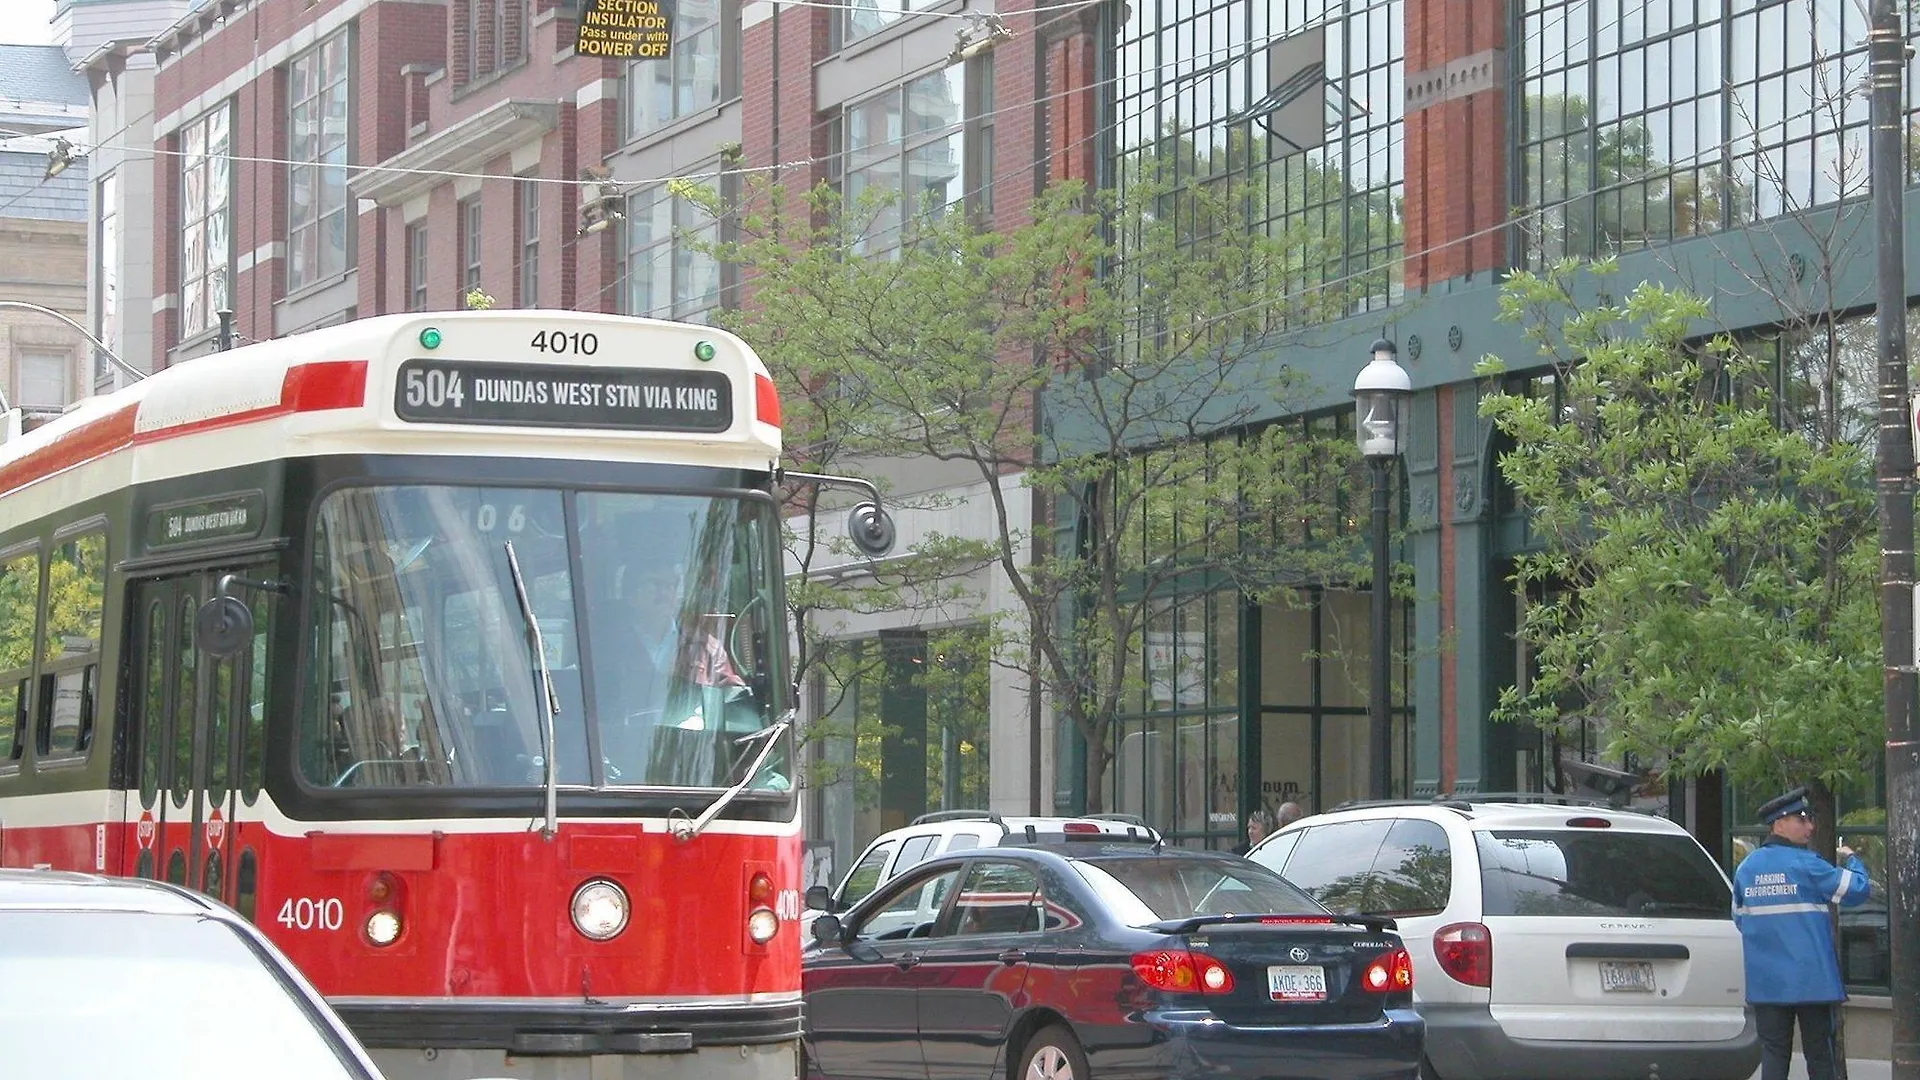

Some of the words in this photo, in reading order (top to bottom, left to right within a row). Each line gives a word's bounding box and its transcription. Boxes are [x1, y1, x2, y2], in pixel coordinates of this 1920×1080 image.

[597, 0, 658, 14] SECTION
[586, 11, 666, 29] INSULATOR
[580, 25, 607, 38] Pass
[610, 29, 643, 41] under
[646, 30, 669, 42] with
[579, 39, 634, 56] POWER
[638, 43, 668, 57] OFF
[531, 330, 598, 355] 4010
[406, 368, 464, 408] 504
[475, 379, 548, 404] DUNDAS
[552, 383, 602, 407] WEST
[606, 385, 640, 408] STN
[644, 386, 673, 410] VIA
[676, 387, 718, 411] KING
[168, 515, 182, 537] 504
[139, 820, 153, 837] STOP
[209, 819, 223, 836] STOP
[1755, 873, 1786, 885] PARKING
[1744, 884, 1798, 897] ENFORCEMENT
[277, 897, 343, 930] 4010
[776, 889, 799, 920] 4010
